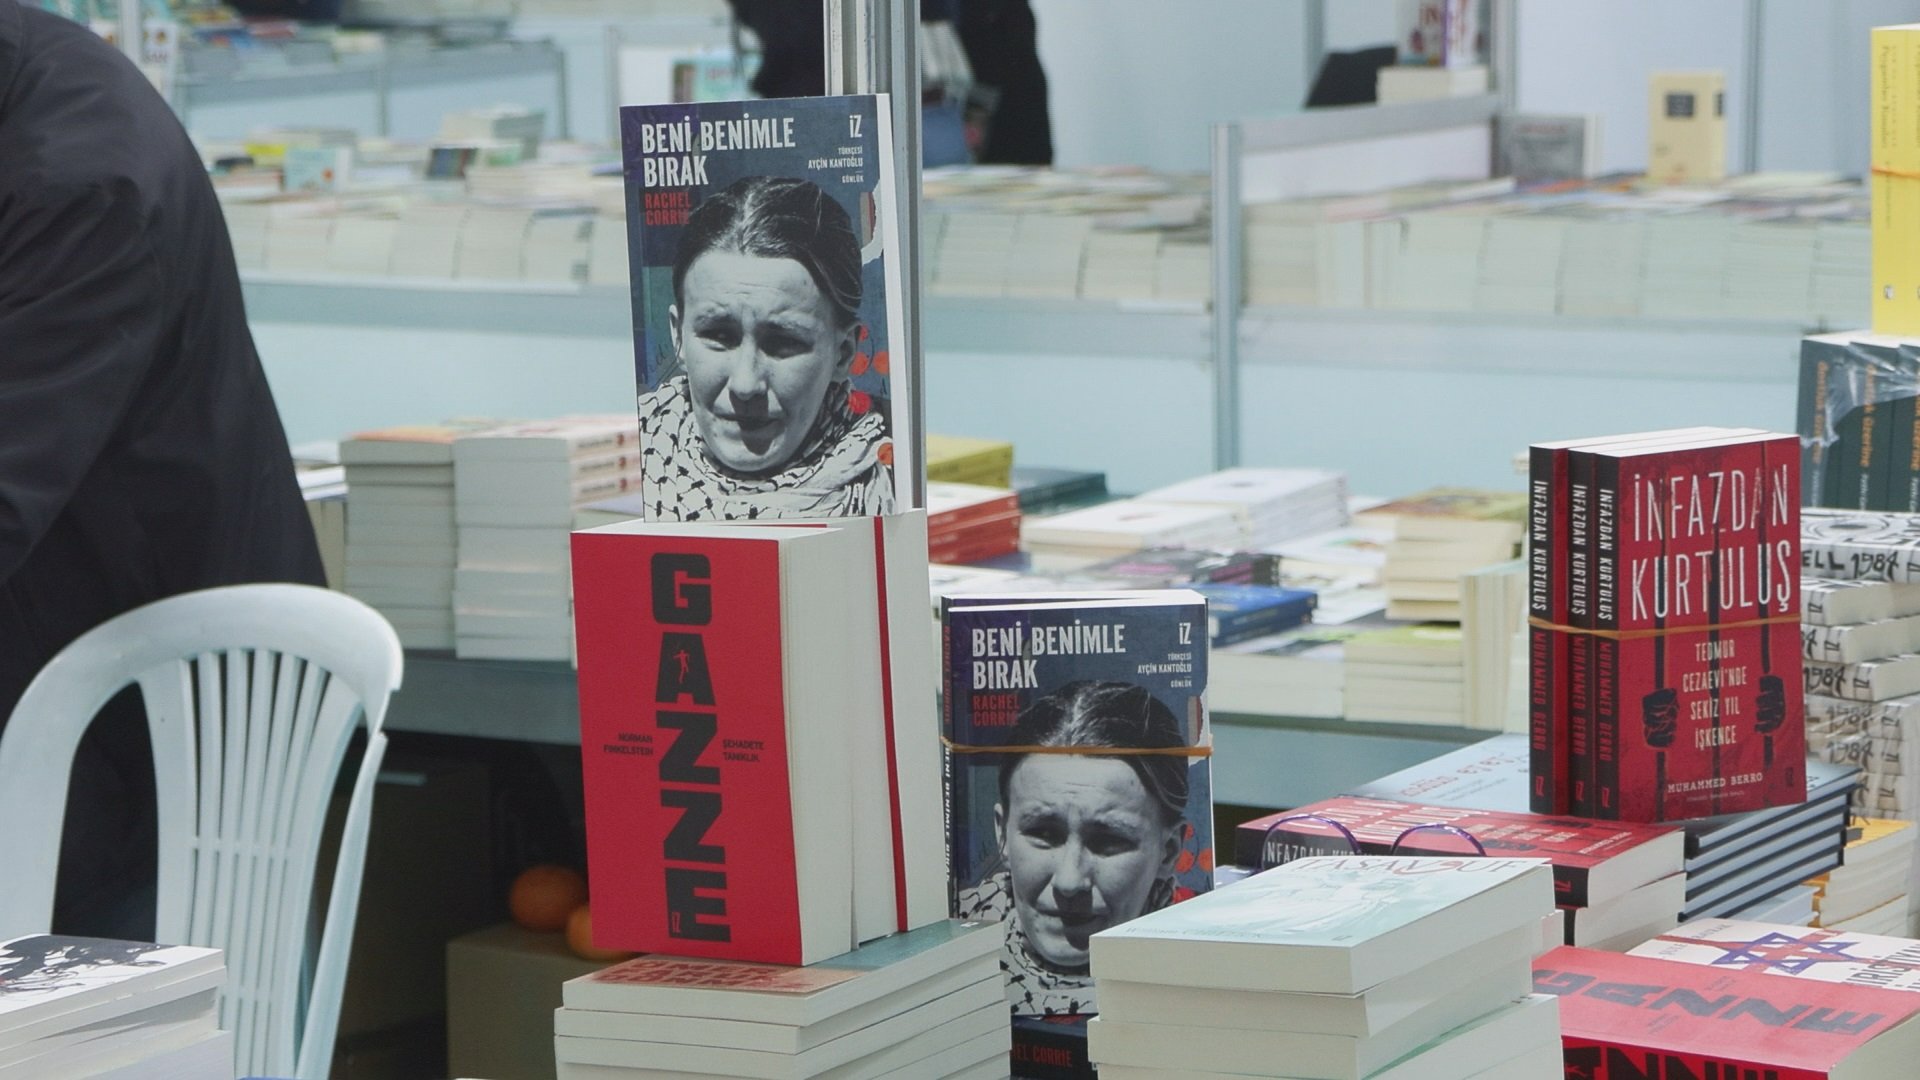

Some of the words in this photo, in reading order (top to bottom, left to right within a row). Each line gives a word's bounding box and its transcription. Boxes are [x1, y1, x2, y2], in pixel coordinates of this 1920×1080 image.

[641, 115, 692, 154] BENİ
[701, 113, 796, 151] BENİMLE
[643, 155, 709, 187] BIRAK
[808, 158, 828, 171] AYÇİN
[829, 155, 863, 168] KANTOĞLU
[644, 191, 692, 209] RACHEL
[645, 209, 690, 225] CORRIE
[1635, 464, 1788, 542] İNFAZDAN
[1802, 550, 1845, 570] ELL
[1851, 550, 1899, 582] 1984
[1633, 540, 1791, 621] KURTULUŞ
[972, 621, 1023, 657] BENİ
[1031, 619, 1126, 655] BENİMLE
[1695, 640, 1735, 662] TEDMUR
[973, 660, 1038, 690] BIRAK
[1137, 664, 1157, 676] AYÇİN
[1158, 661, 1192, 673] KANTOĞLU
[1682, 666, 1747, 693] CEZAEVİ'NDE
[972, 694, 1020, 710] RACHEL
[1690, 697, 1719, 720] SEKİZ
[1725, 696, 1740, 716] YIL
[618, 732, 653, 743] NORMAN
[651, 553, 731, 943] GAZZE
[723, 739, 764, 751] ŞEHADETE
[1695, 725, 1737, 750] İŞKENCE
[604, 745, 653, 756] FINKELSTEIN
[723, 752, 760, 763] TANIKLIK
[1667, 778, 1726, 793] MUHAMMED
[1731, 772, 1763, 785] BERRO
